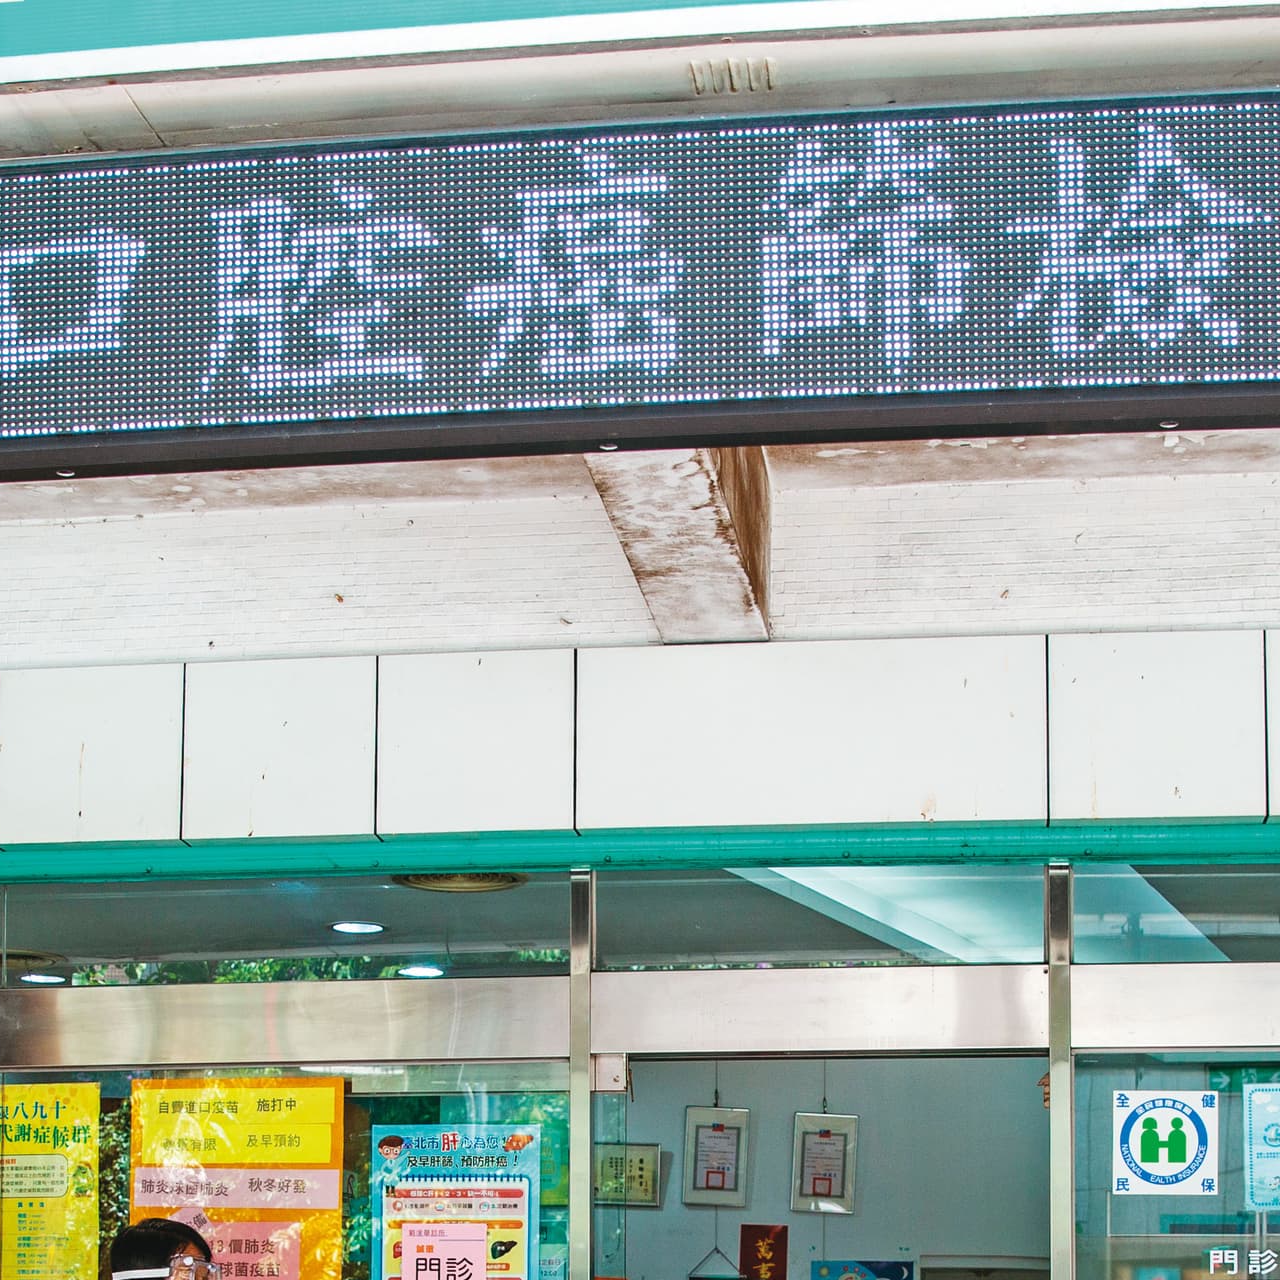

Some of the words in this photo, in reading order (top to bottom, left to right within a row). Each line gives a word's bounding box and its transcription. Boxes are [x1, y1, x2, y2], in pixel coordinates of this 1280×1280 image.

[256, 1098, 297, 1112] 施打中
[1116, 1093, 1130, 1108] 全
[1201, 1094, 1216, 1108] 健
[1121, 1144, 1143, 1177] NATIONAL
[248, 1177, 306, 1194] 秋冬好發
[1115, 1178, 1130, 1192] 民
[1201, 1178, 1216, 1193] 保
